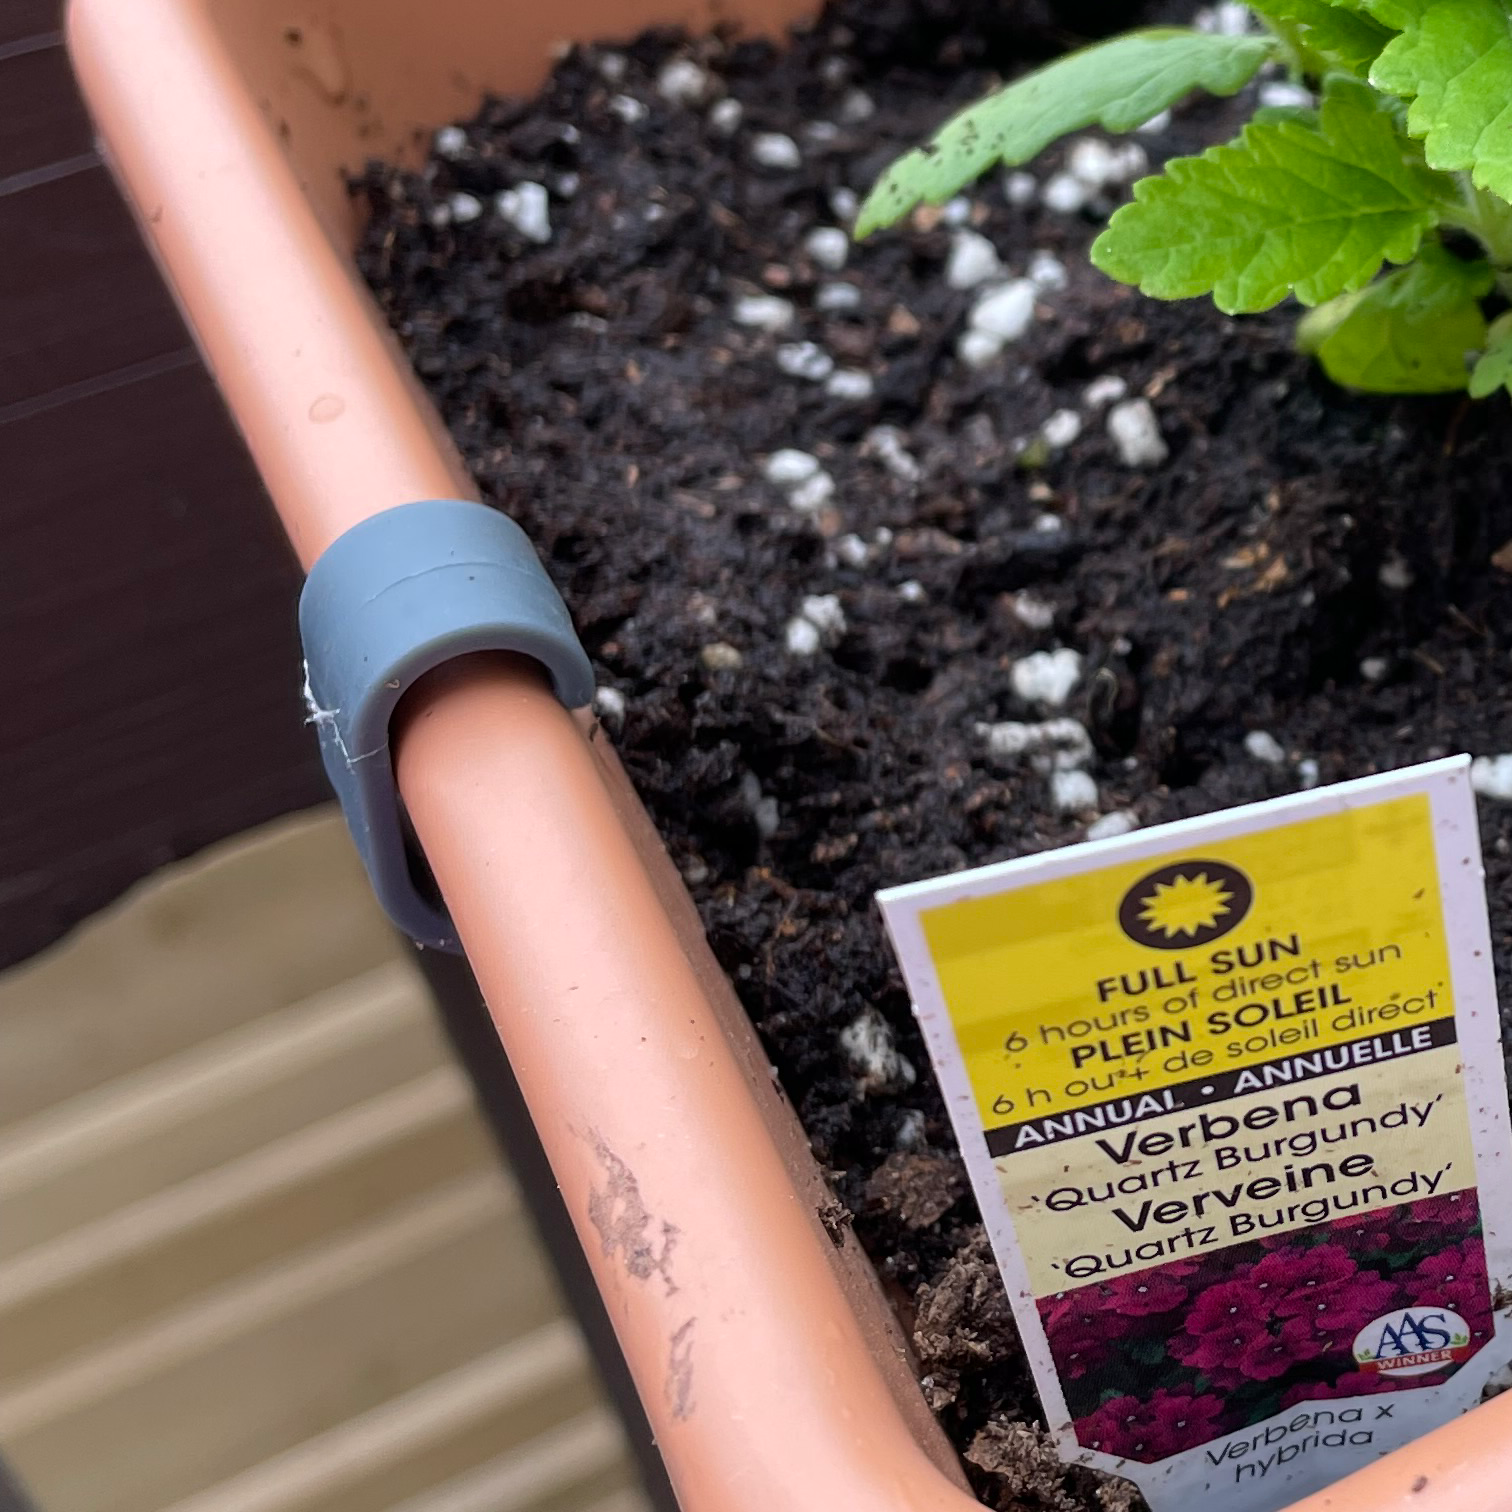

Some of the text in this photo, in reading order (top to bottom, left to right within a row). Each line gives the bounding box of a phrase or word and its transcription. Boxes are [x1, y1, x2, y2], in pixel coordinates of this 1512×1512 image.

[1005, 944, 1402, 1052] 6 hours of direct sun
[1097, 933, 1300, 1003] FULL SUN
[992, 1094, 1015, 1115] 6
[1026, 1088, 1052, 1107] h
[1163, 1050, 1214, 1073] de
[1226, 1018, 1319, 1058] soleil
[1332, 989, 1438, 1032] direct
[1071, 983, 1352, 1069] PLEIN SOLEIL
[1233, 1026, 1433, 1094] ANNUELLE
[1095, 1083, 1361, 1165] Verbena
[1112, 1153, 1374, 1232] Verveine
[1375, 1311, 1451, 1359] AAS
[1376, 1349, 1453, 1370] WINNER
[1206, 1403, 1395, 1466] Verbena x
[1235, 1430, 1373, 1483] hybrida
